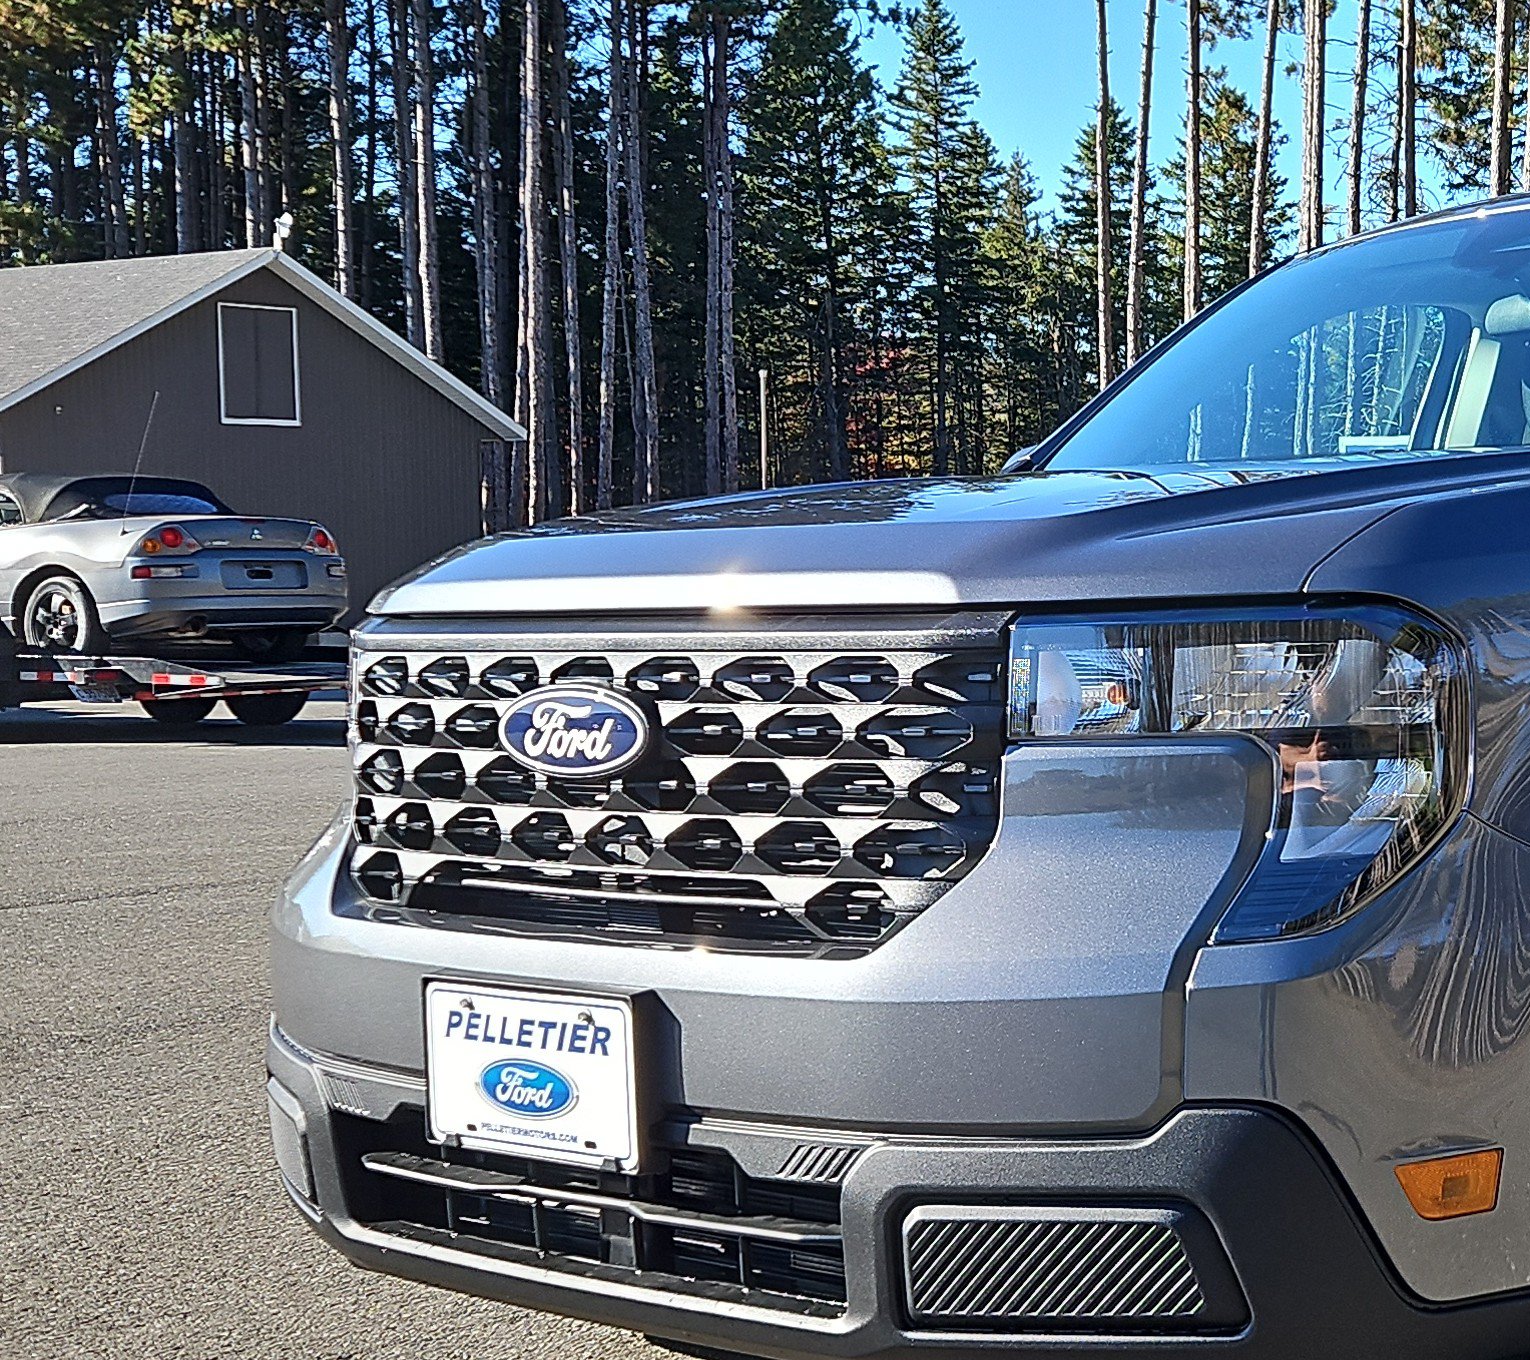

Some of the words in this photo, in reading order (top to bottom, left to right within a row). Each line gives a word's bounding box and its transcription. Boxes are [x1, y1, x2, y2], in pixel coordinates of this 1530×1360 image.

[523, 701, 614, 760] Ford
[445, 1010, 612, 1056] PELLETIER
[495, 1066, 554, 1109] Ford
